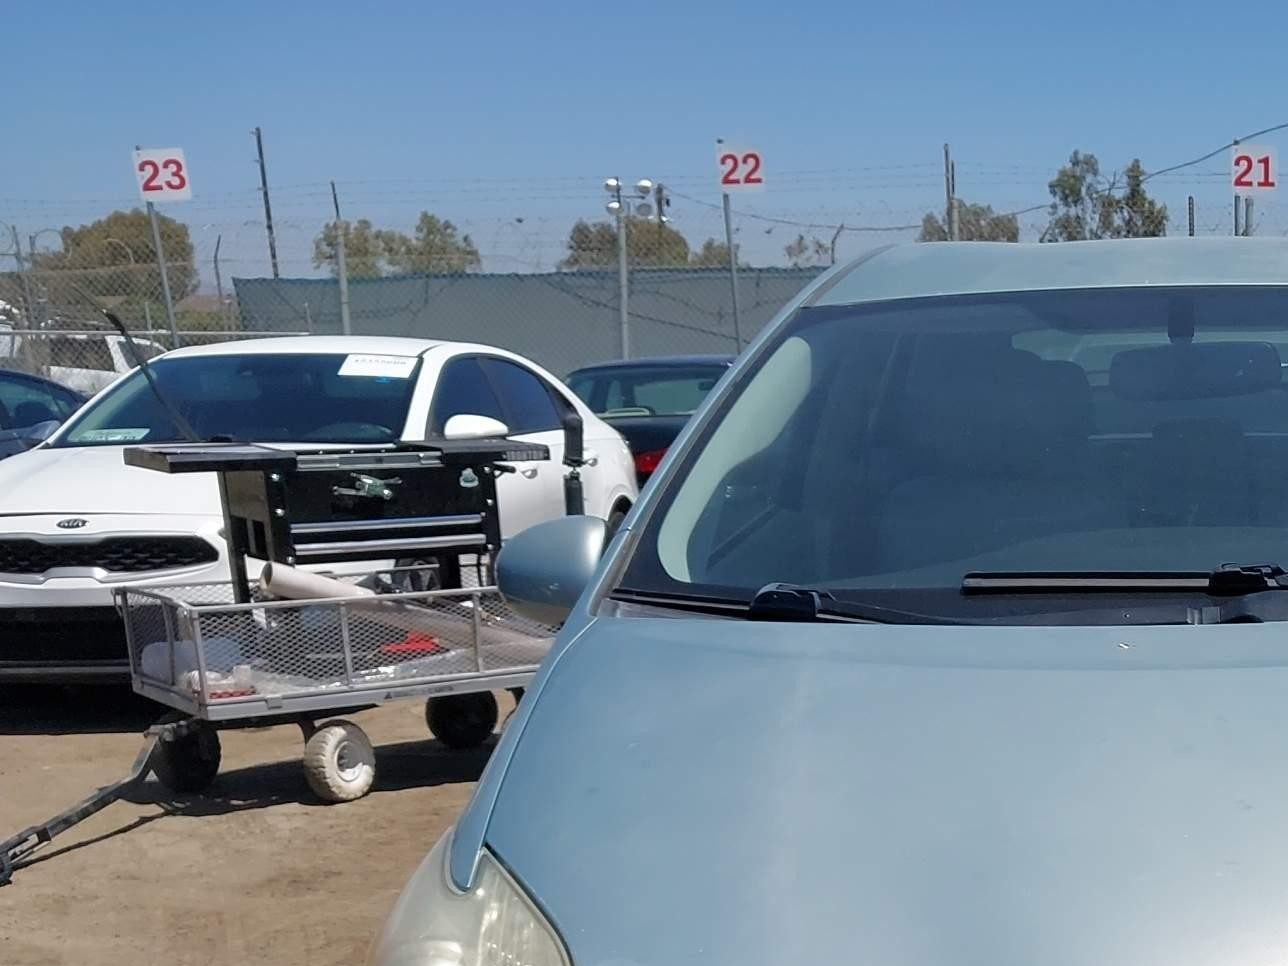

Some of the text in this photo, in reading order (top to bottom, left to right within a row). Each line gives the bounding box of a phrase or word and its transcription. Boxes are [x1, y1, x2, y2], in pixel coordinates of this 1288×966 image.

[138, 159, 187, 192] 23
[720, 154, 762, 186] 22
[1233, 155, 1275, 188] 21
